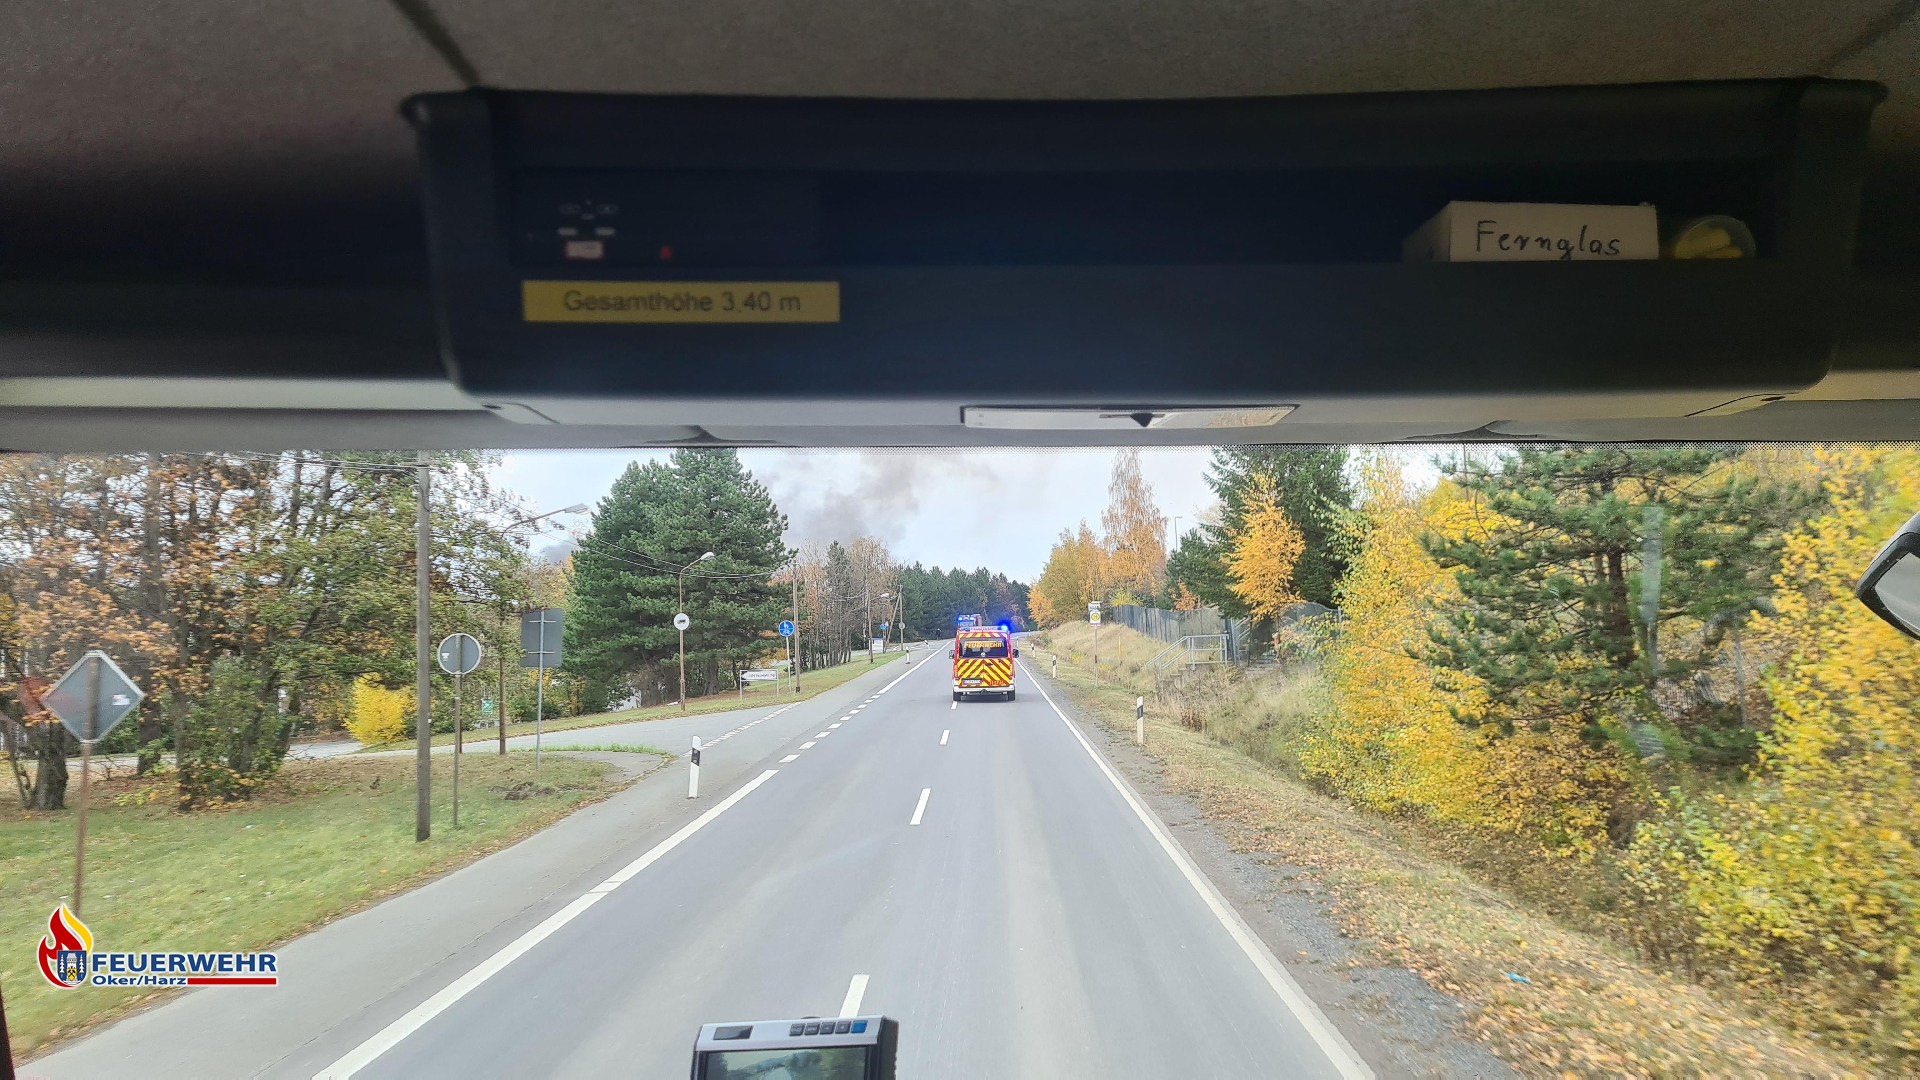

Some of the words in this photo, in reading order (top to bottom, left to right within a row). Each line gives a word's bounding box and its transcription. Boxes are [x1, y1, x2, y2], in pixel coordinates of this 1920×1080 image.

[1476, 220, 1620, 260] Fernglas
[563, 289, 713, 311] Gesamthöhe
[779, 296, 801, 311] m
